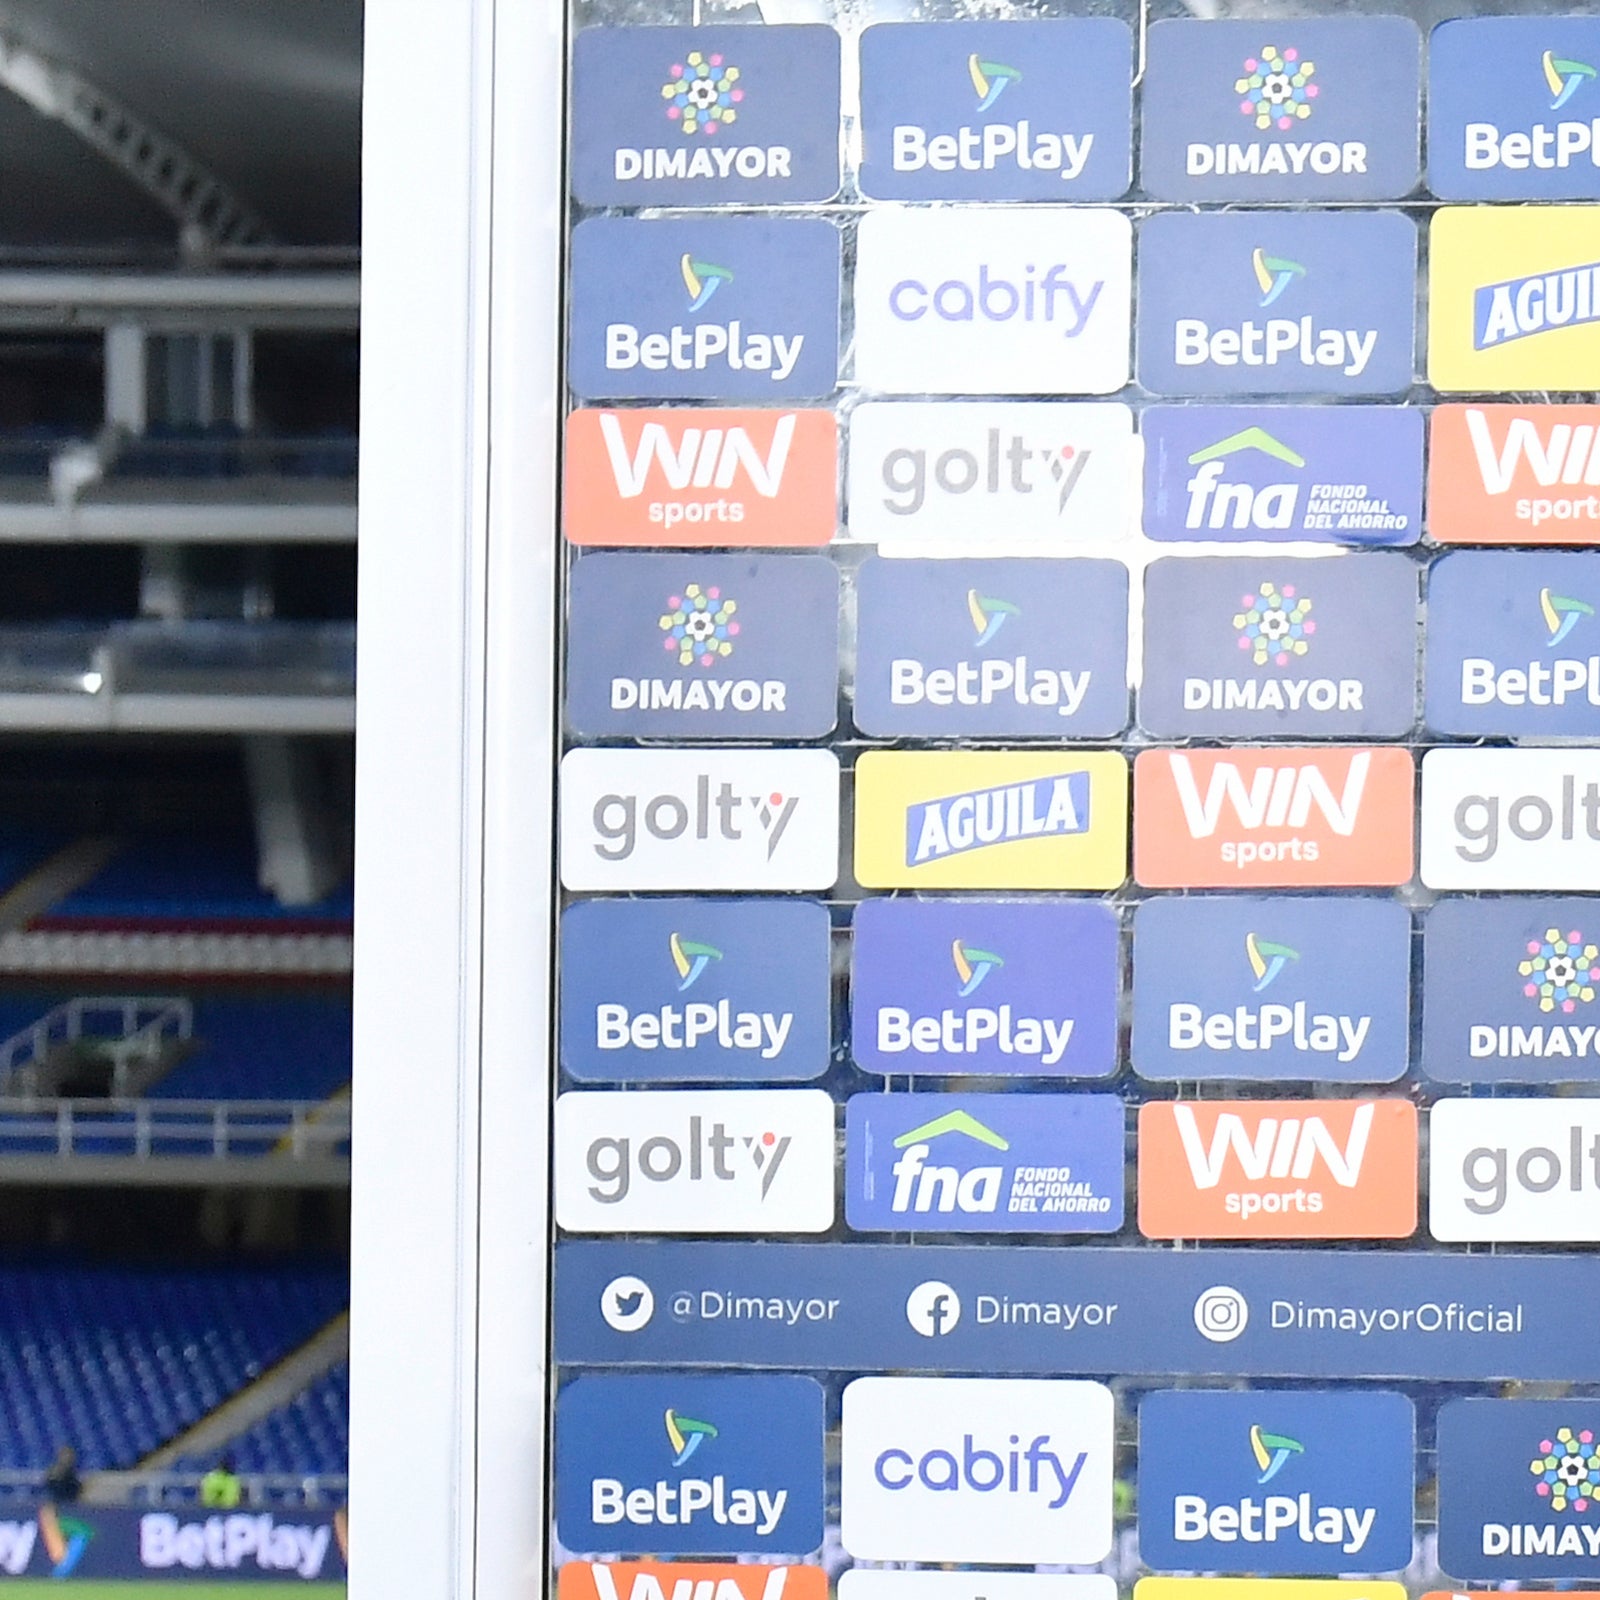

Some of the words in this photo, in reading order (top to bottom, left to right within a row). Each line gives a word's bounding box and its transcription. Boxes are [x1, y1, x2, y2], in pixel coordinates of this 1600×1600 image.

[616, 147, 791, 179] DIMAYOR
[894, 121, 1093, 179] BetPlay
[1187, 143, 1366, 175] DIMAYOR
[889, 264, 1104, 338] cabify
[607, 321, 804, 380] BetPlay
[1176, 316, 1377, 376] BetPlay
[600, 413, 796, 497] WIN
[882, 428, 1091, 515] golty
[649, 499, 744, 528] sports
[1186, 461, 1298, 529] fna
[1304, 514, 1333, 528] DEL
[1342, 515, 1407, 529] AHORRO
[1307, 499, 1389, 513] NACIONAL
[1311, 485, 1367, 499] FONDO
[612, 679, 785, 711] DIMAYOR
[892, 656, 1091, 715] BetPlay
[1184, 679, 1363, 710] DIMAYOR
[593, 775, 799, 861] golty
[914, 778, 1080, 862] AGUILA
[1169, 750, 1371, 838] WIN
[1221, 837, 1319, 868] sports
[598, 999, 792, 1058] BetPlay
[878, 1005, 1073, 1064] BetPlay
[1170, 1001, 1370, 1061] BetPlay
[587, 1116, 791, 1204] golty
[1015, 1168, 1070, 1182] FONDO
[1173, 1102, 1374, 1189] WIN
[893, 1145, 1002, 1212] fna
[1008, 1198, 1038, 1212] DEL
[1042, 1198, 1110, 1212] AHORRO
[1011, 1183, 1092, 1197] NACIONAL
[1226, 1189, 1323, 1219] sports
[671, 1291, 840, 1324] @Dimayor
[977, 1296, 1117, 1329] Dimayor
[1272, 1301, 1521, 1335] DimayorOficial
[875, 1435, 1088, 1509] cabify
[593, 1476, 787, 1534] BetPlay
[1175, 1493, 1375, 1553] BetPlay
[141, 1514, 328, 1577] BetPlay
